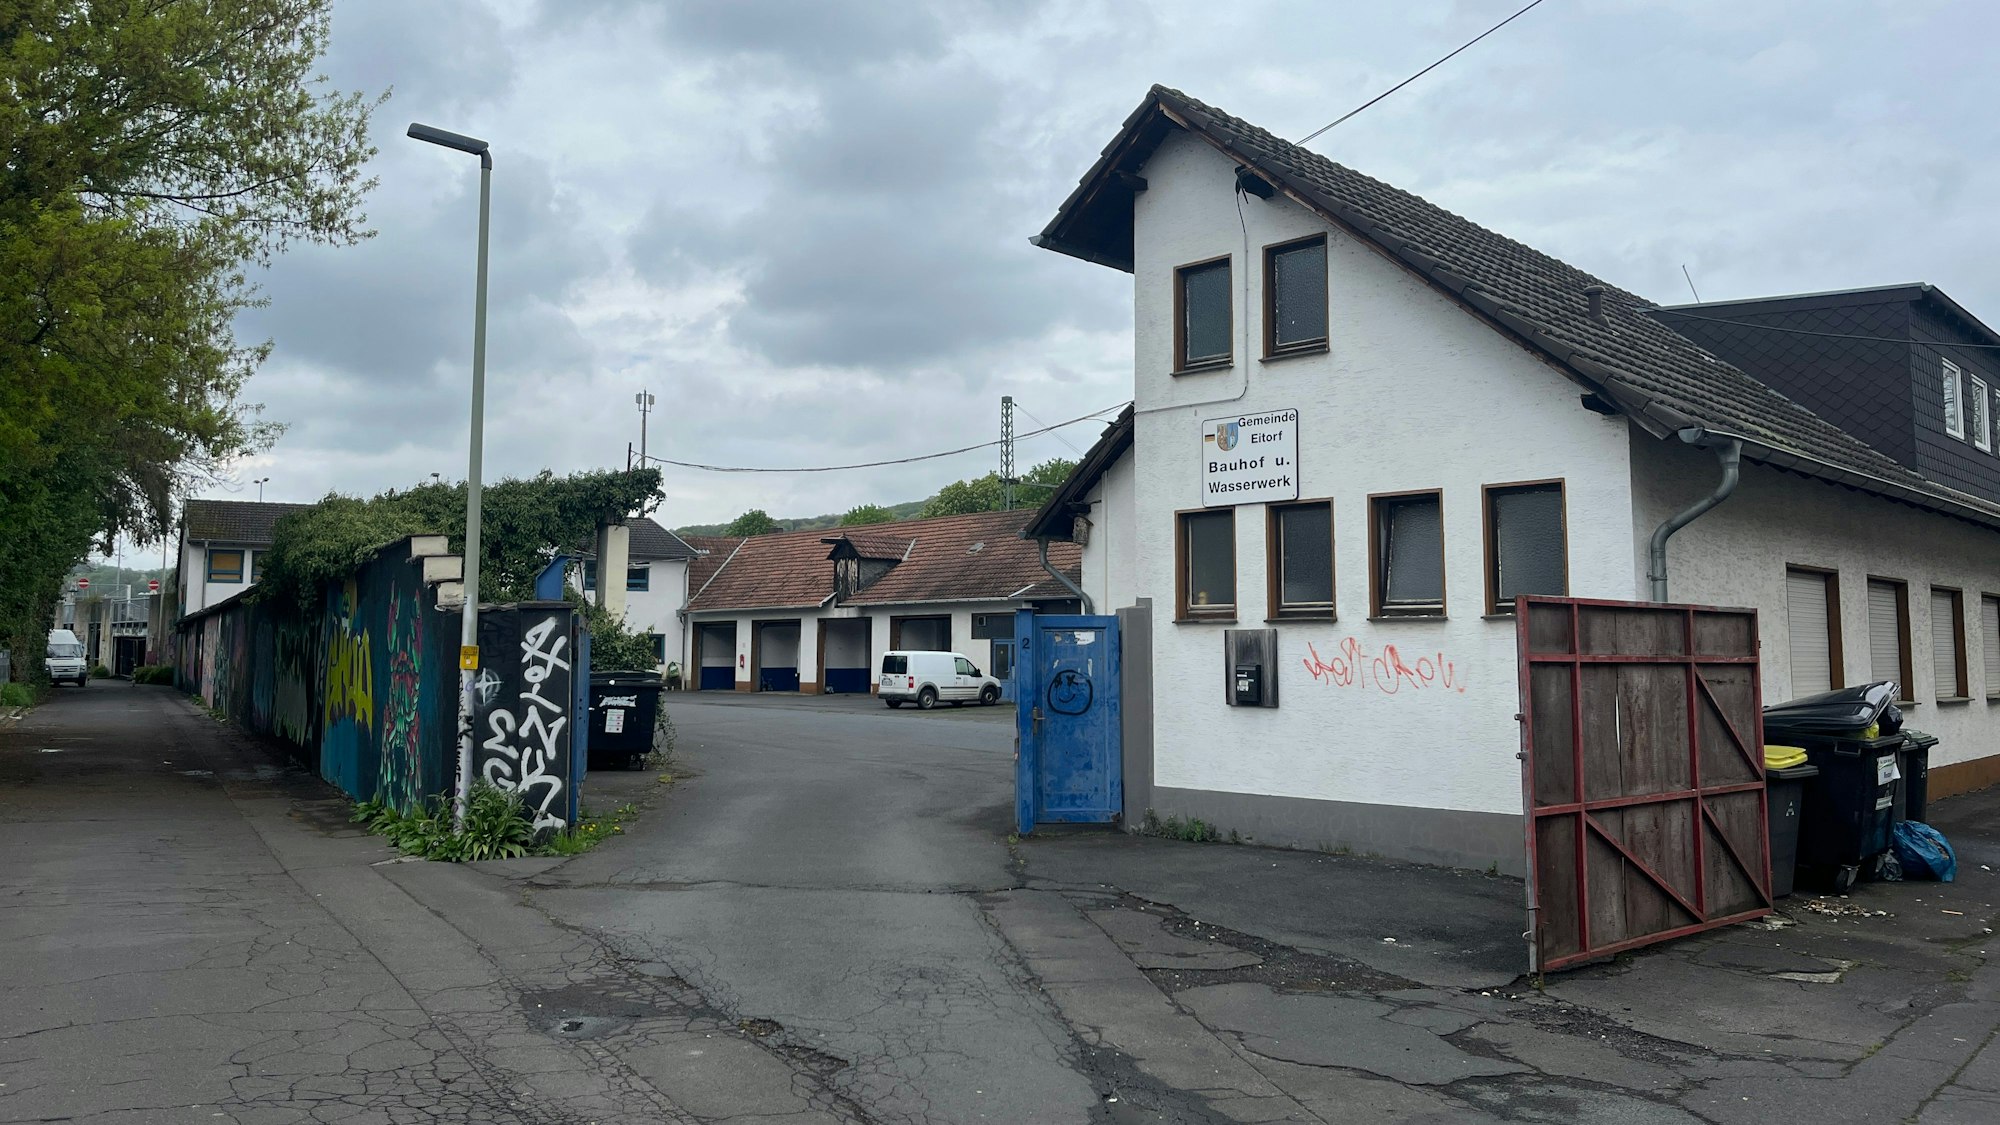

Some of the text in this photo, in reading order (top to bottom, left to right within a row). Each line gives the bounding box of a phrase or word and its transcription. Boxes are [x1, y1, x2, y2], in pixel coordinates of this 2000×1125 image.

[1238, 412, 1295, 427] Gemeinde
[1251, 430, 1283, 444] Eitorf
[1209, 456, 1290, 473] Bauhof u.
[1209, 475, 1291, 494] Wasserwerk
[1022, 637, 1030, 649] 2
